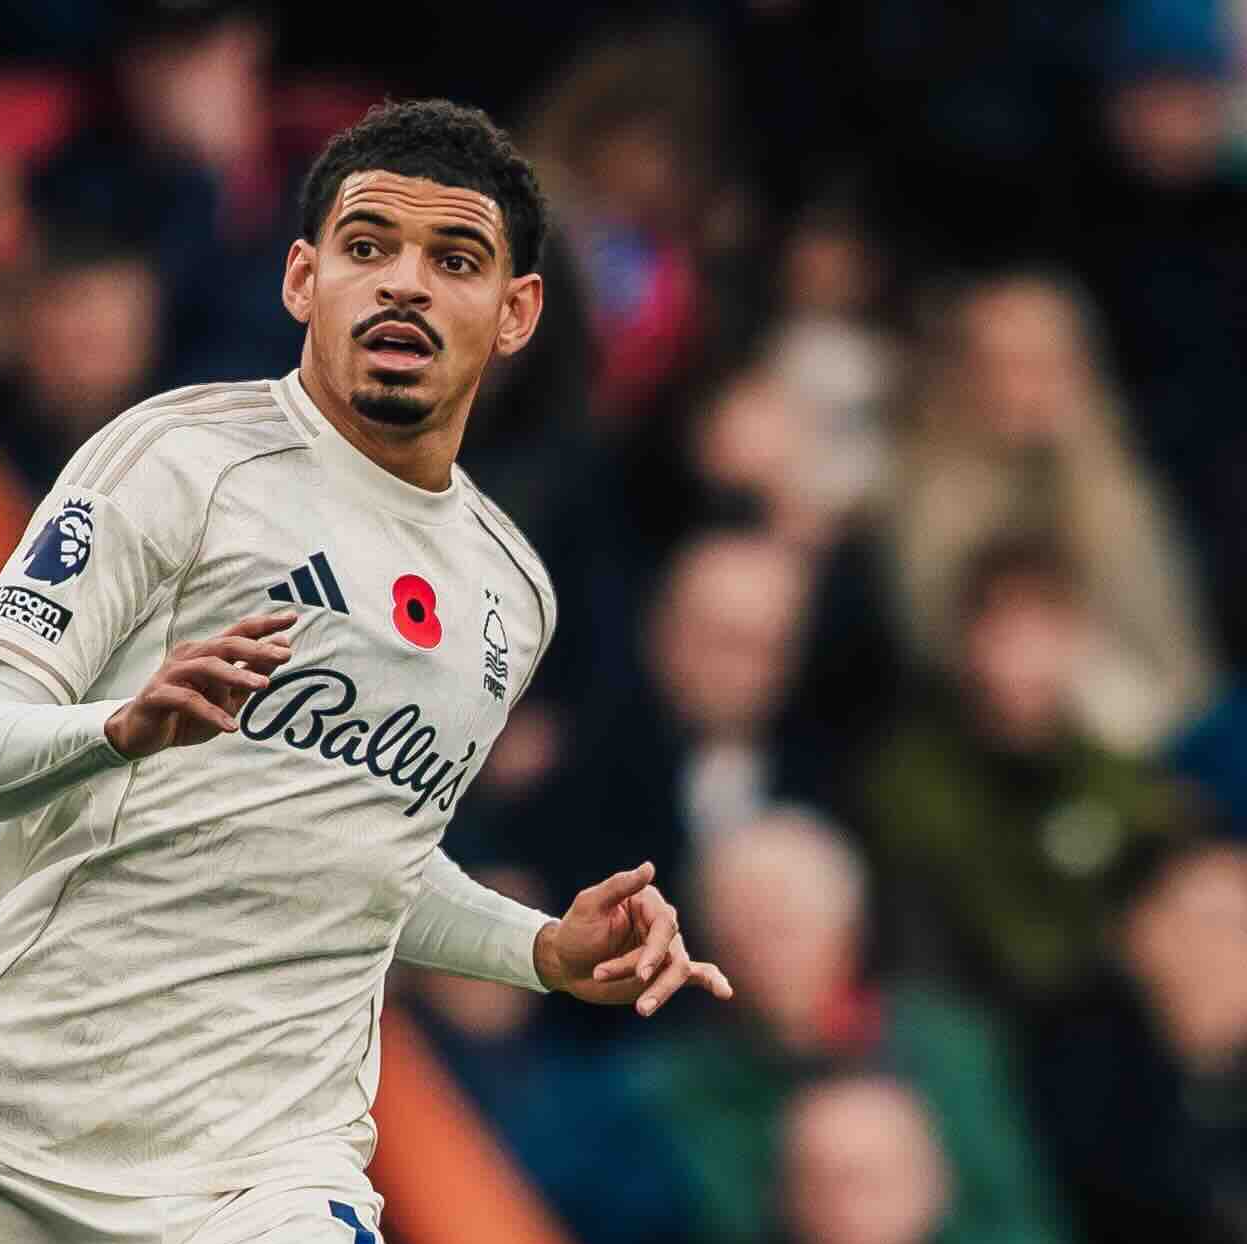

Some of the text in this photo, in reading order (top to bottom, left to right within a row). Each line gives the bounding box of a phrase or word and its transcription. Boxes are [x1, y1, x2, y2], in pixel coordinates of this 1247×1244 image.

[0, 604, 62, 644] racism
[8, 590, 61, 625] room
[240, 668, 476, 817] Bally's
